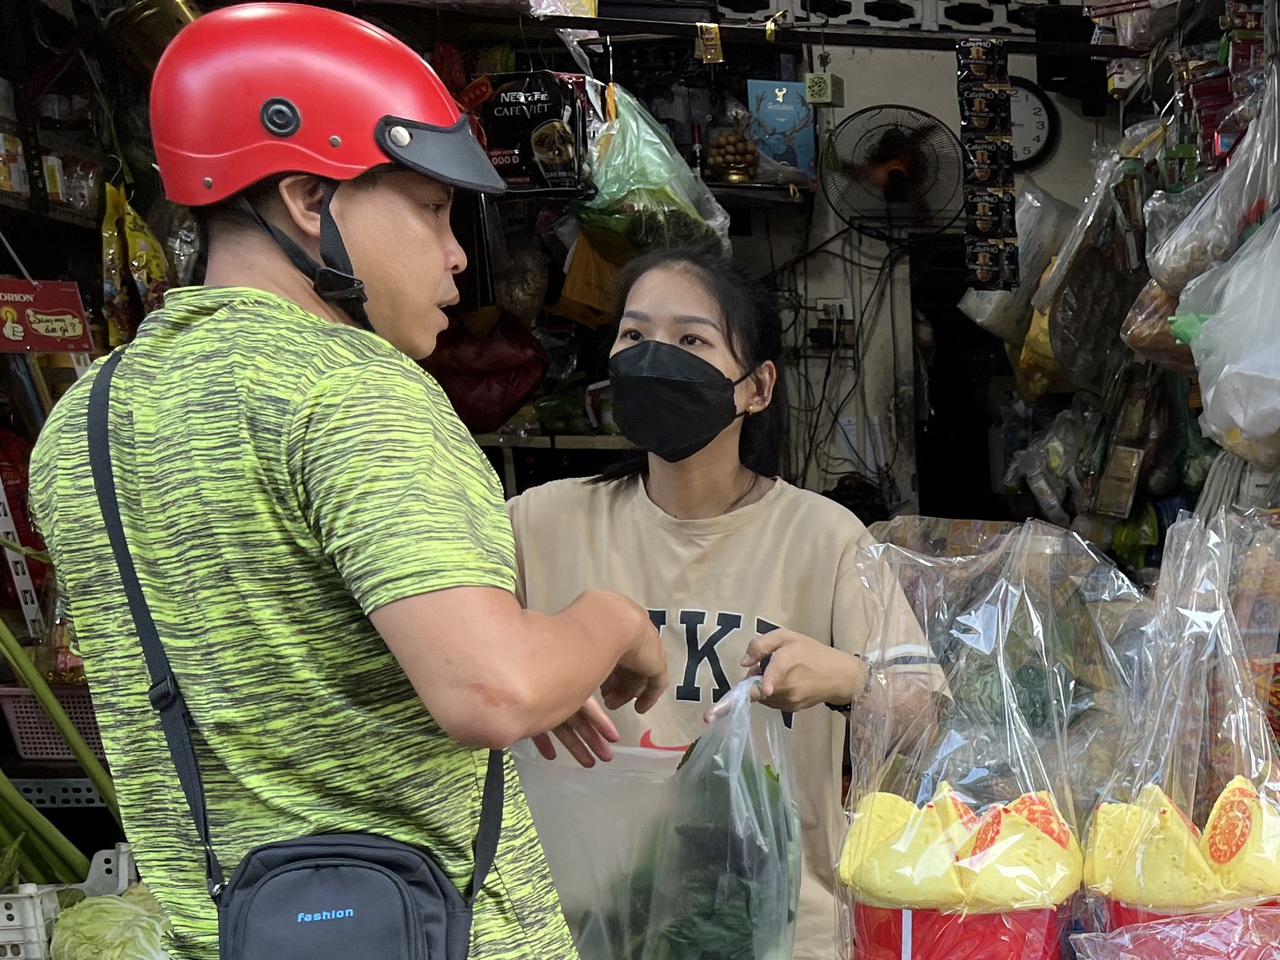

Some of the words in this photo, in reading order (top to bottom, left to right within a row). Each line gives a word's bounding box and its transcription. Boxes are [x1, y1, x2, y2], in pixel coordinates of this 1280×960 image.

[1033, 107, 1042, 116] 2
[1036, 121, 1045, 130] 3
[1032, 135, 1041, 143] 4
[1023, 147, 1031, 155] 5
[0, 293, 34, 302] ORION
